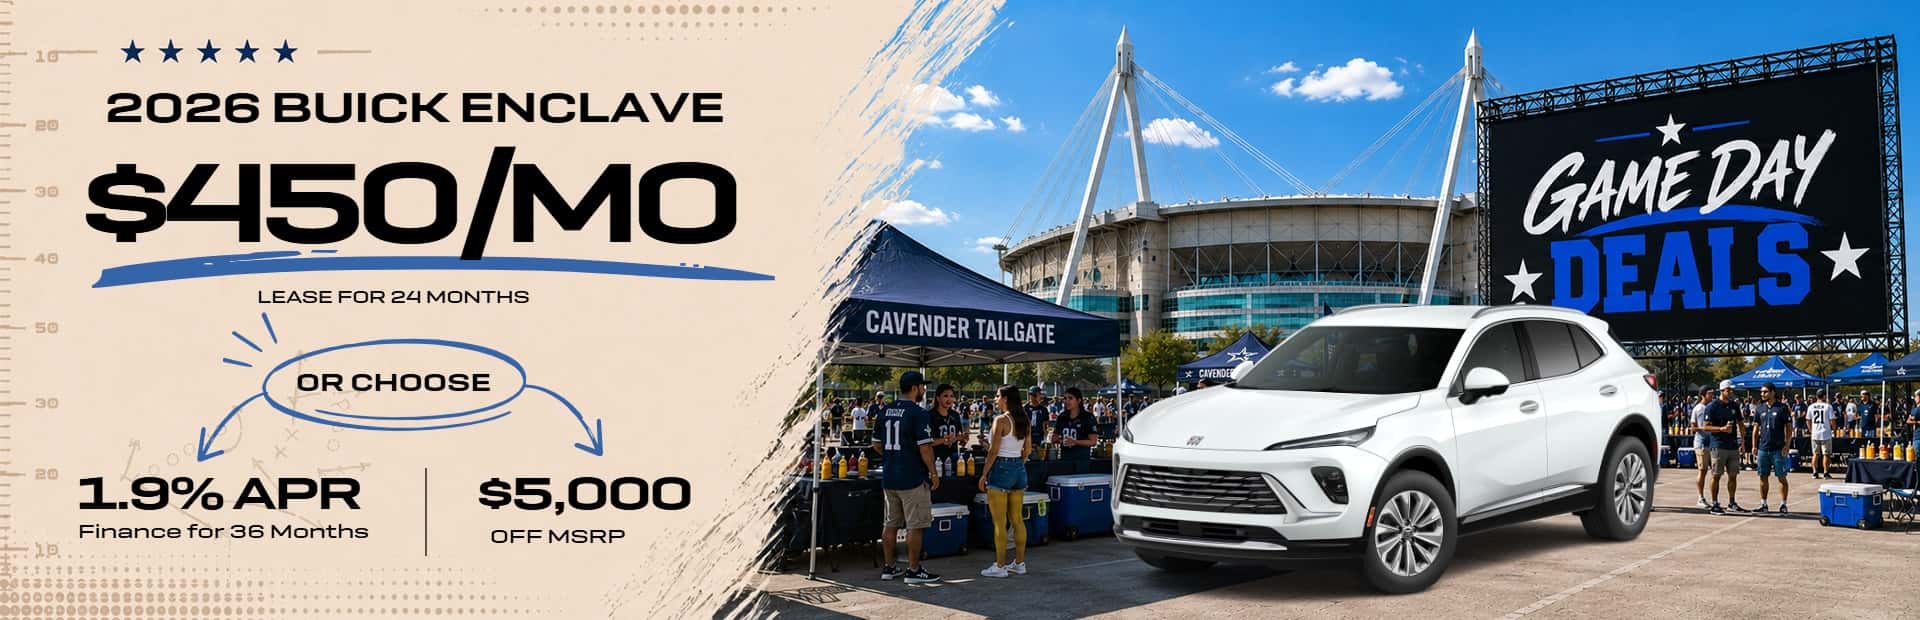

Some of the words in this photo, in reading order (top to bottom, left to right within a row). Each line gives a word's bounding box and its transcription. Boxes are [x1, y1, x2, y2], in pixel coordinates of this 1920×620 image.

[1523, 151, 1700, 235] GAME
[1699, 129, 1836, 215] DAY
[1551, 222, 1811, 314] DEALS
[866, 310, 969, 339] CAVENDER
[975, 318, 1055, 344] TAILGATE
[1814, 410, 1824, 424] 21
[885, 420, 901, 450] 11
